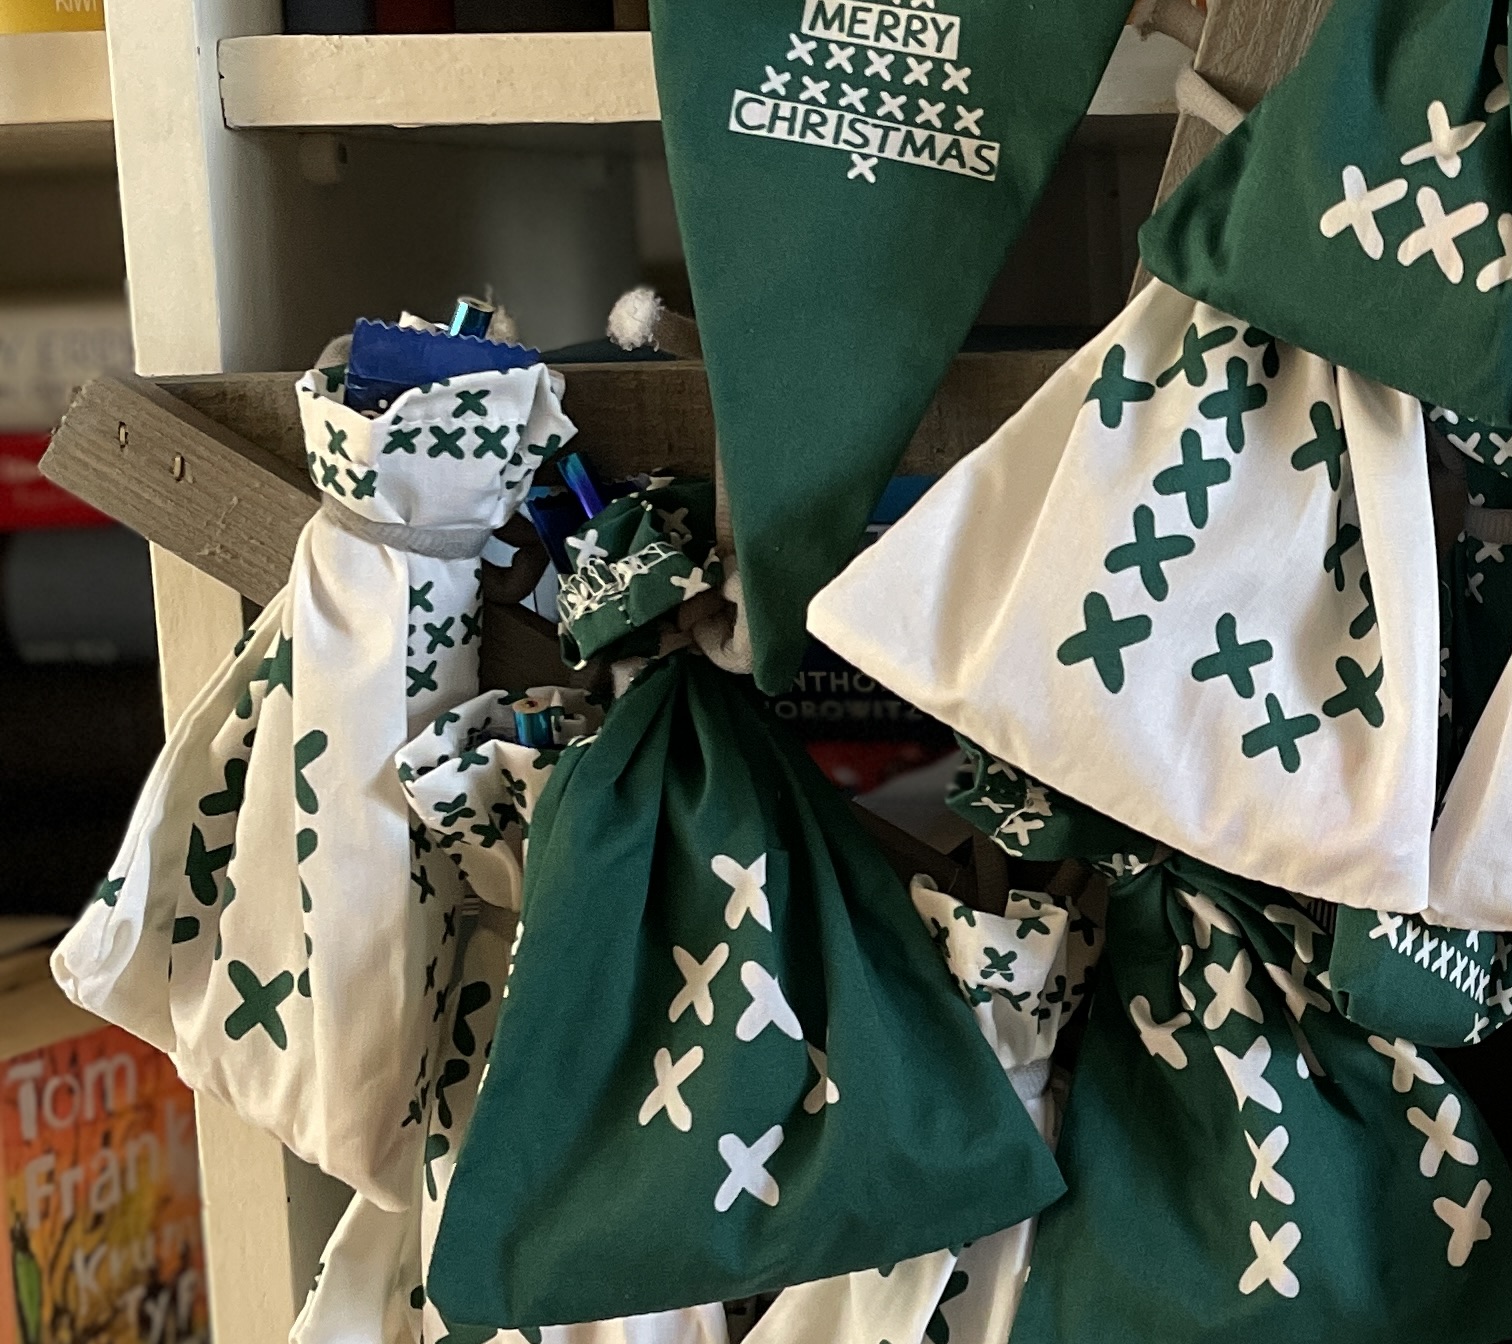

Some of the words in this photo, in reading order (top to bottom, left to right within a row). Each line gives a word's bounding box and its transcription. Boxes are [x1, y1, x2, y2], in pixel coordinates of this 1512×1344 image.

[808, 0, 955, 54] MERRY
[735, 97, 996, 178] CHRISTMAS
[5, 1052, 138, 1141] Tom
